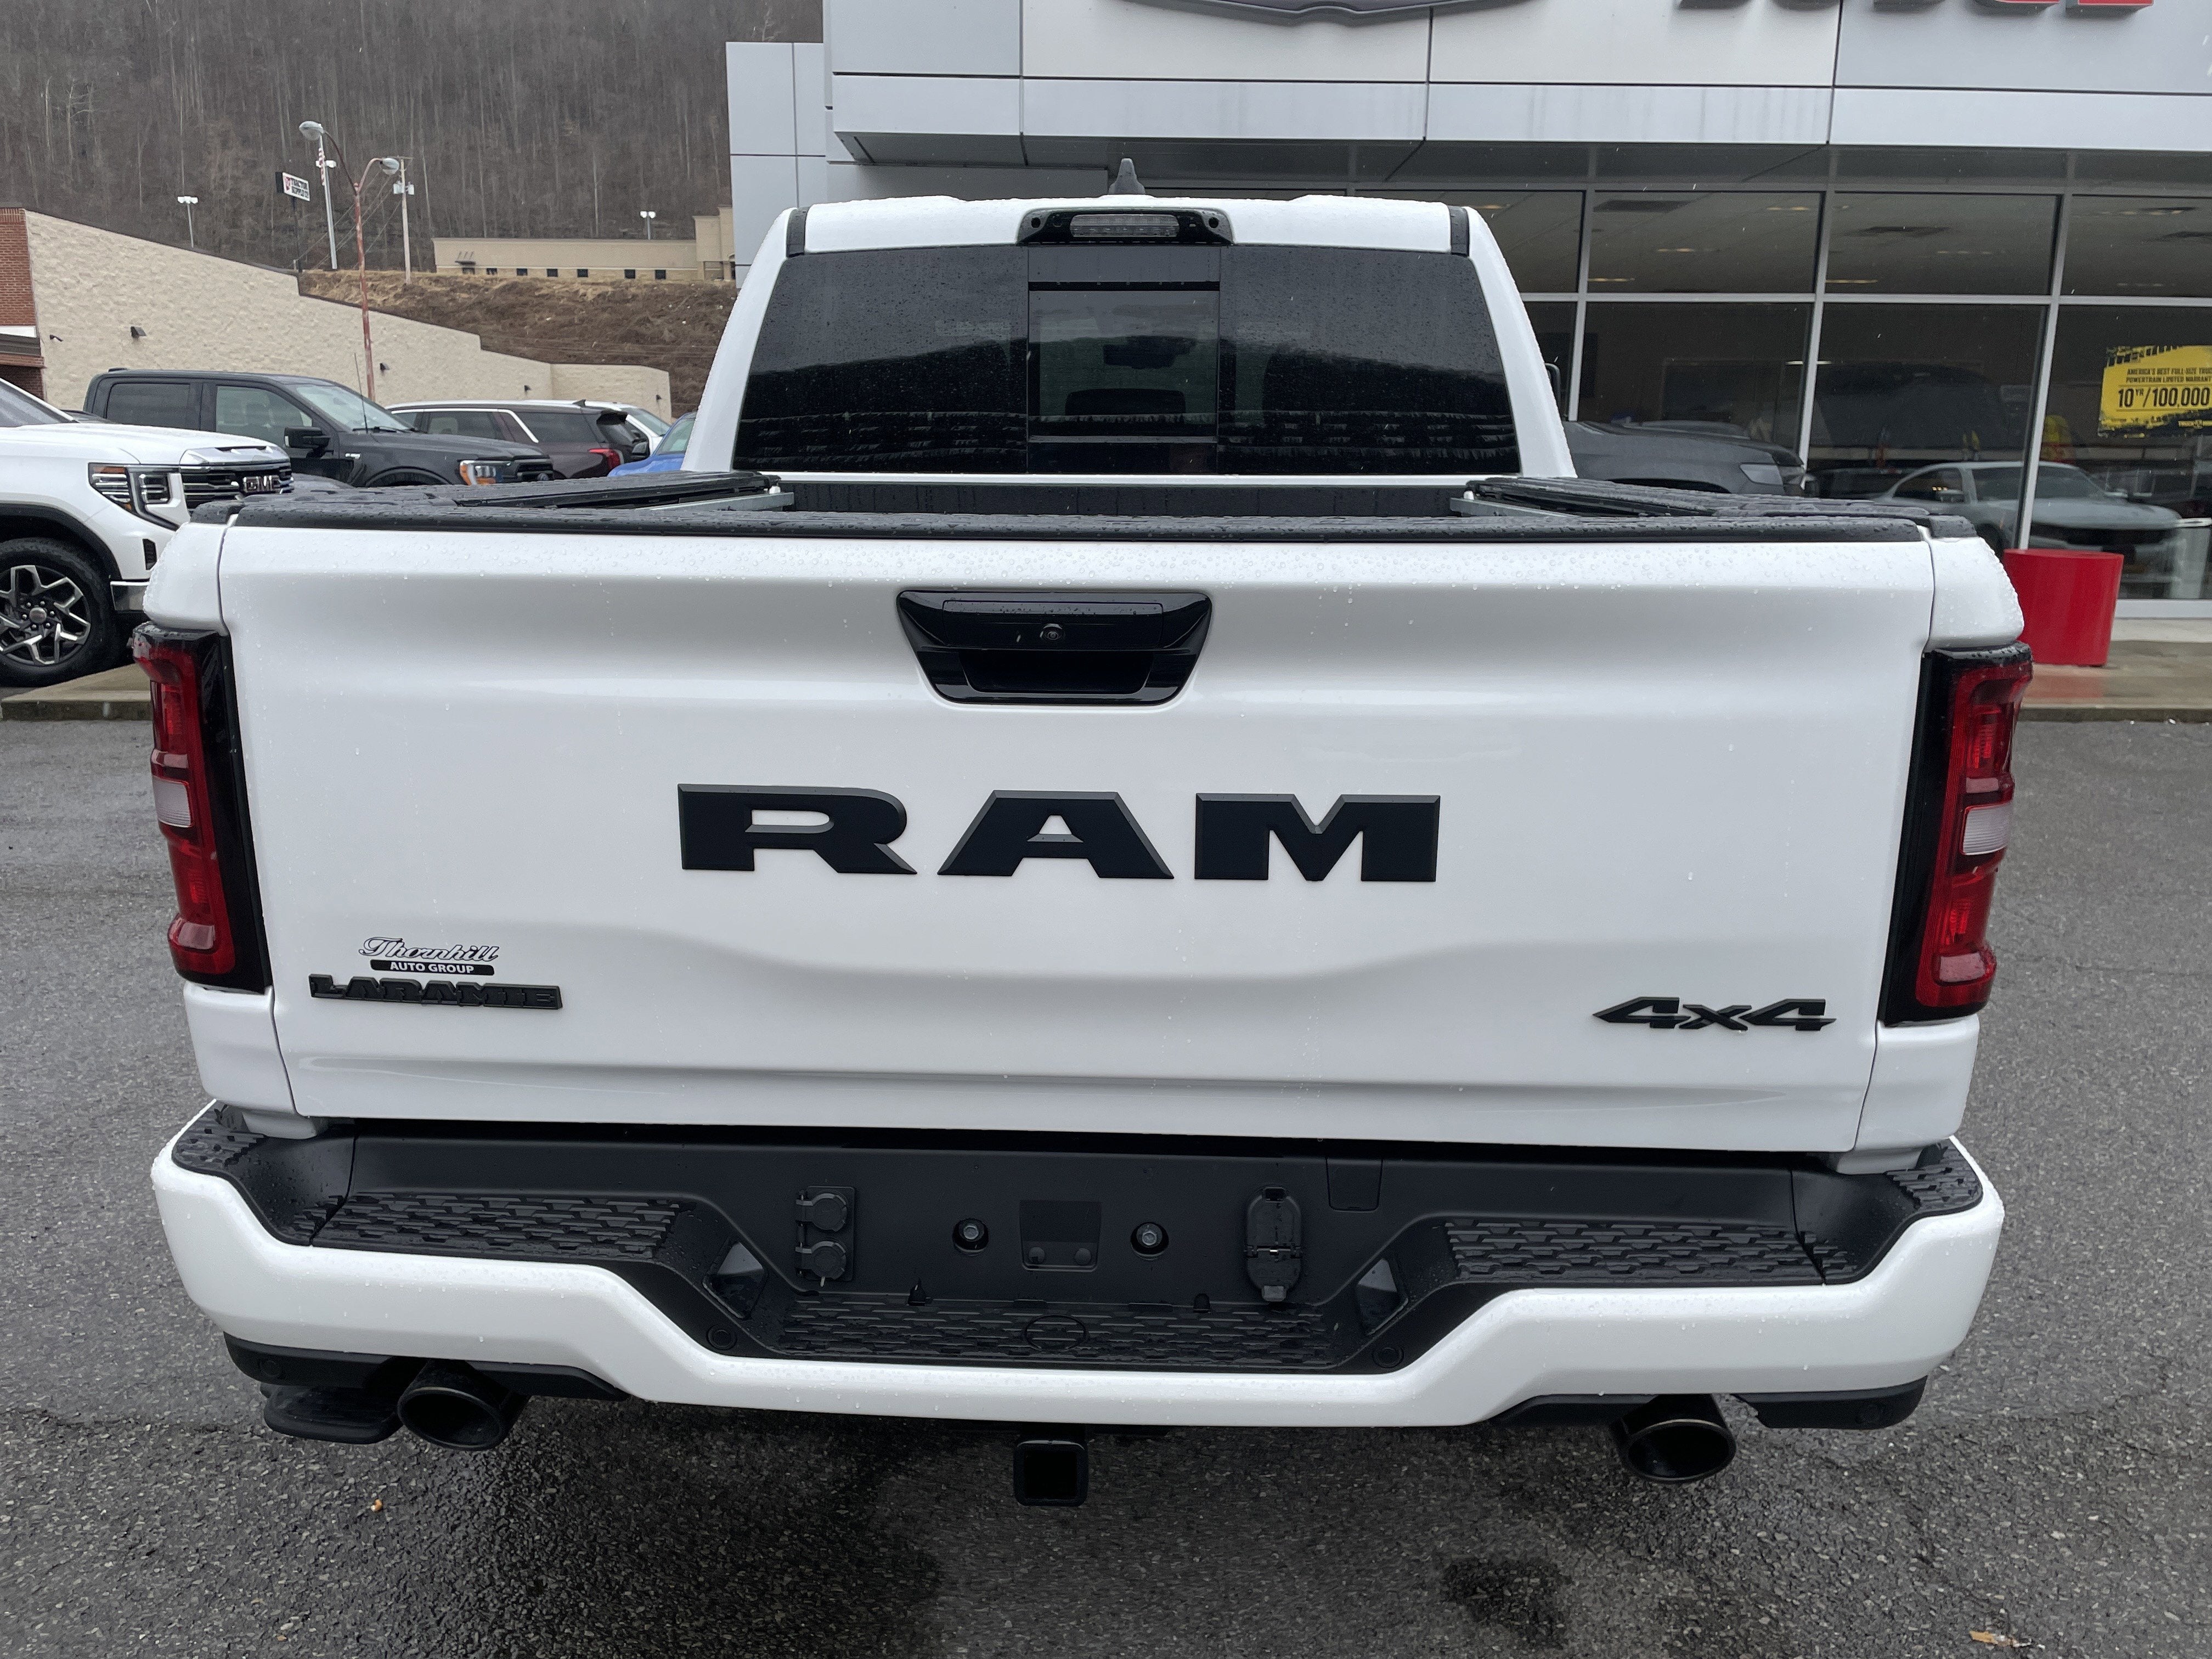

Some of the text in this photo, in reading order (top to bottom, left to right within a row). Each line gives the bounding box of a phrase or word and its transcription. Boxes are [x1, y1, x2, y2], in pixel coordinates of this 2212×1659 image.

[243, 475, 281, 493] GMC
[677, 783, 1441, 882] RAM
[358, 936, 499, 962] Thornhill
[390, 962, 475, 974] AUTO GROUP
[308, 974, 563, 1009] LARAMIE
